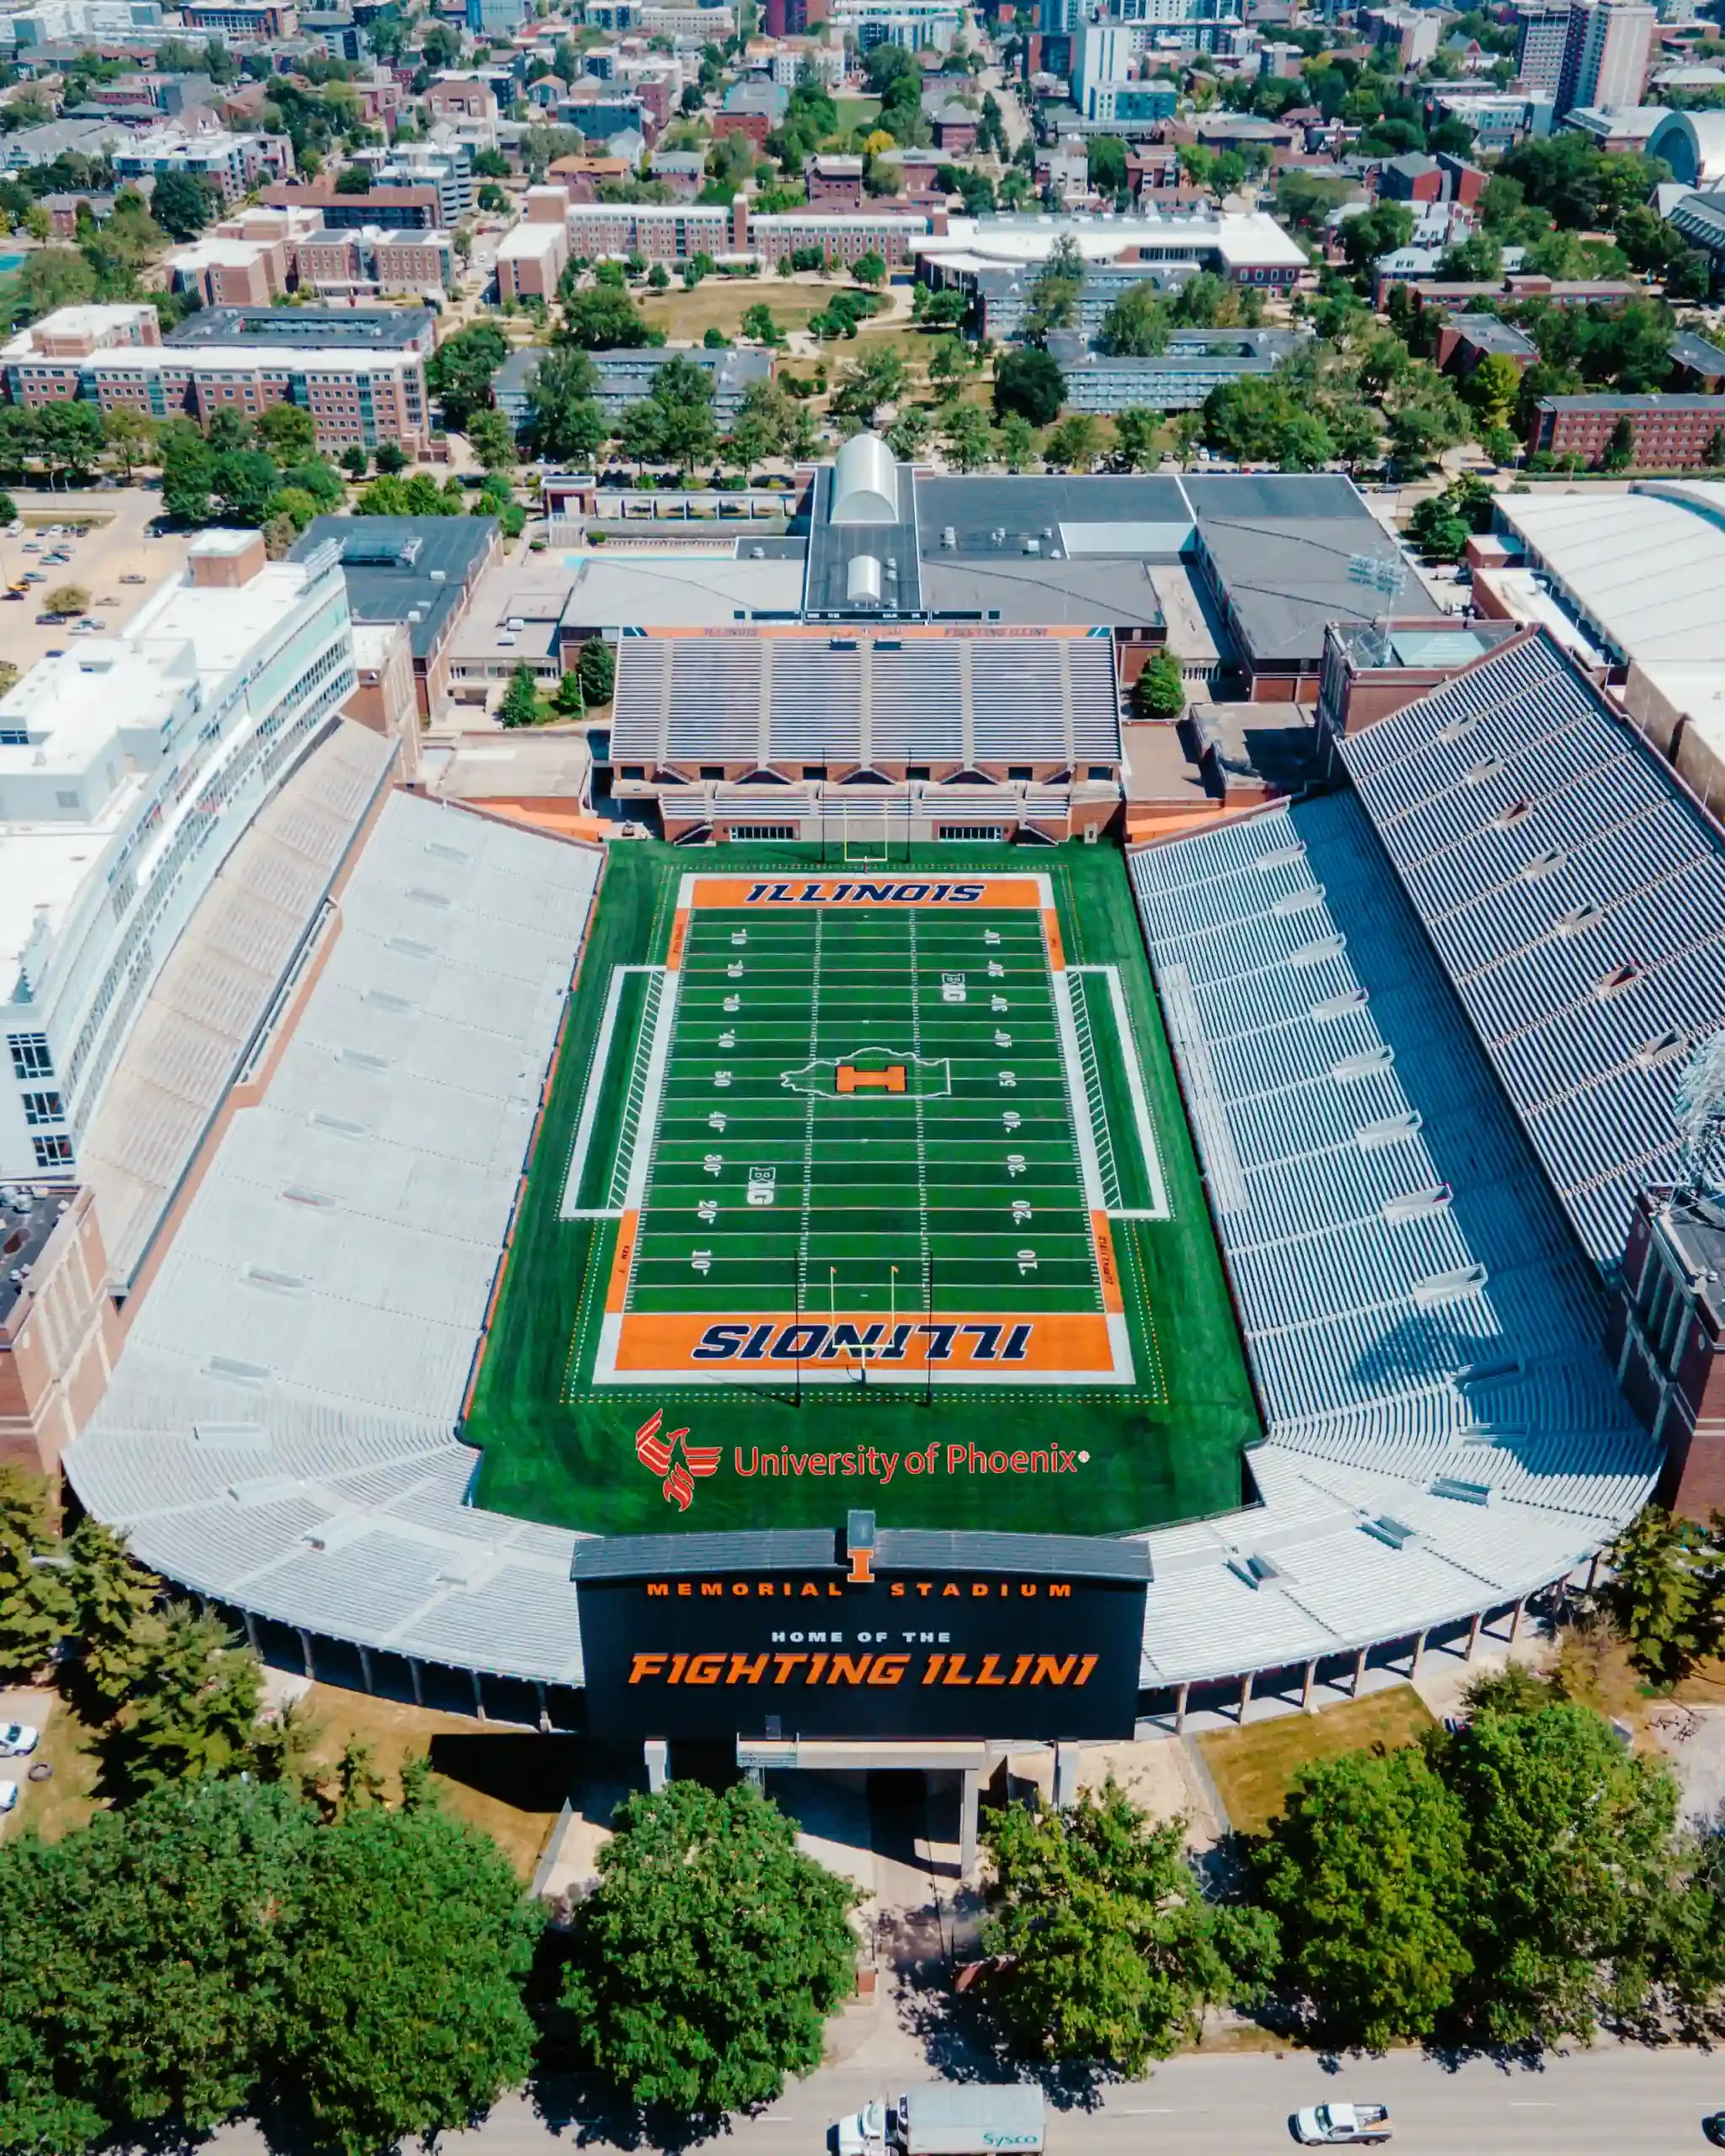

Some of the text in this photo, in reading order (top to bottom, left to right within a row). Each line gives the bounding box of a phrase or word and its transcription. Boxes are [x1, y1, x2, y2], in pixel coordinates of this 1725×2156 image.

[744, 883, 986, 903] ILLINOIS
[998, 1071, 1017, 1087] 50
[691, 1323, 1033, 1361] ILLINOIS
[734, 1442, 1078, 1484] University of Phoenix
[846, 1548, 875, 1582] I
[647, 1582, 1071, 1597] MEMORIAL STADIUM
[772, 1631, 951, 1643] HOME OF THE
[628, 1653, 1098, 1685] FIGHTING ILLINI
[983, 2132, 1038, 2147] Sysco
